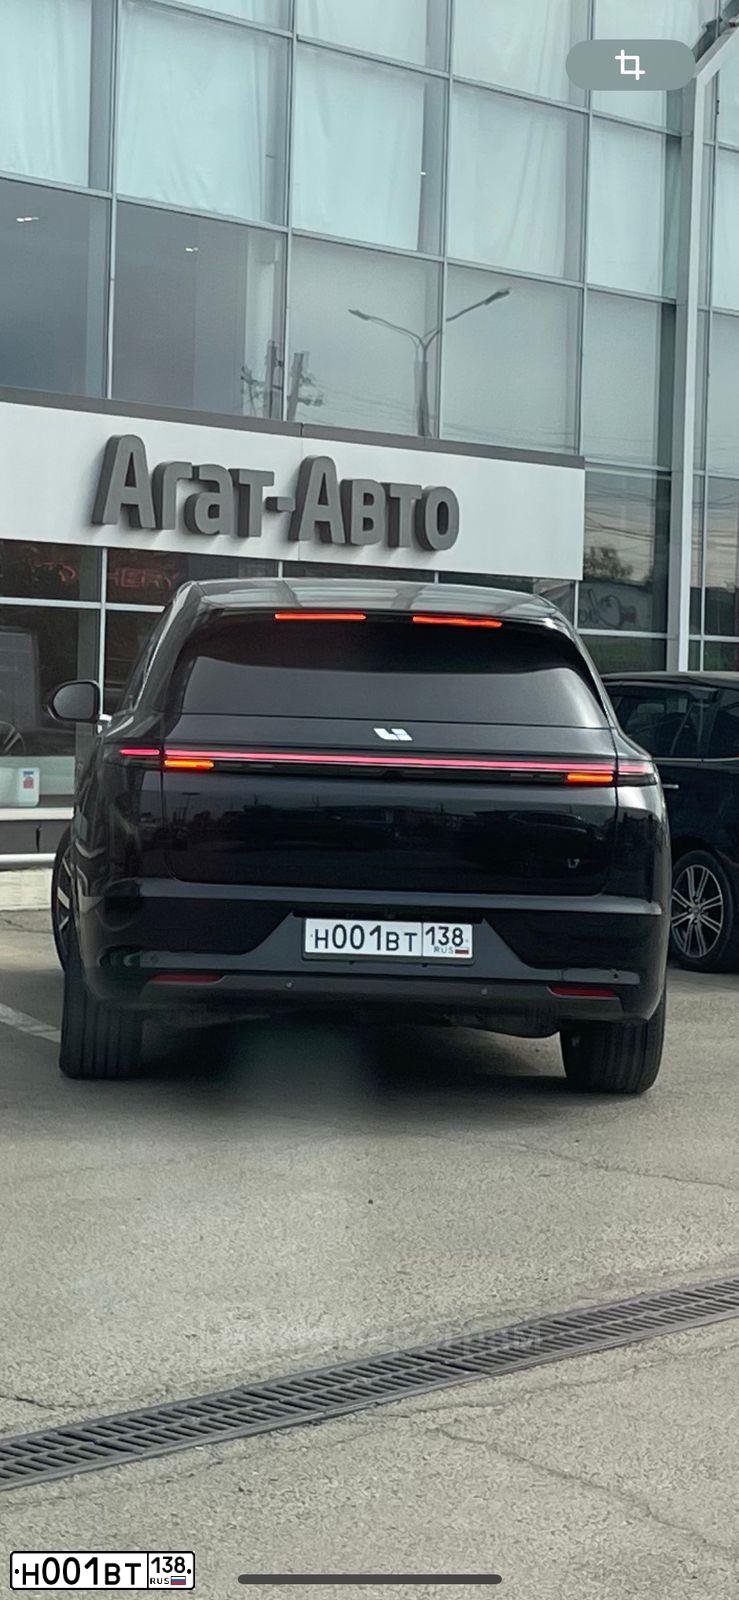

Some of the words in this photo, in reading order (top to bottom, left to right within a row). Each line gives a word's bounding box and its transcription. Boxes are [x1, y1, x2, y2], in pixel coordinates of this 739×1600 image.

[92, 434, 460, 551] Агат-Авто
[107, 567, 178, 588] HERY
[314, 924, 418, 952] Н001ВТ
[425, 926, 464, 947] 138
[433, 946, 454, 955] RUS
